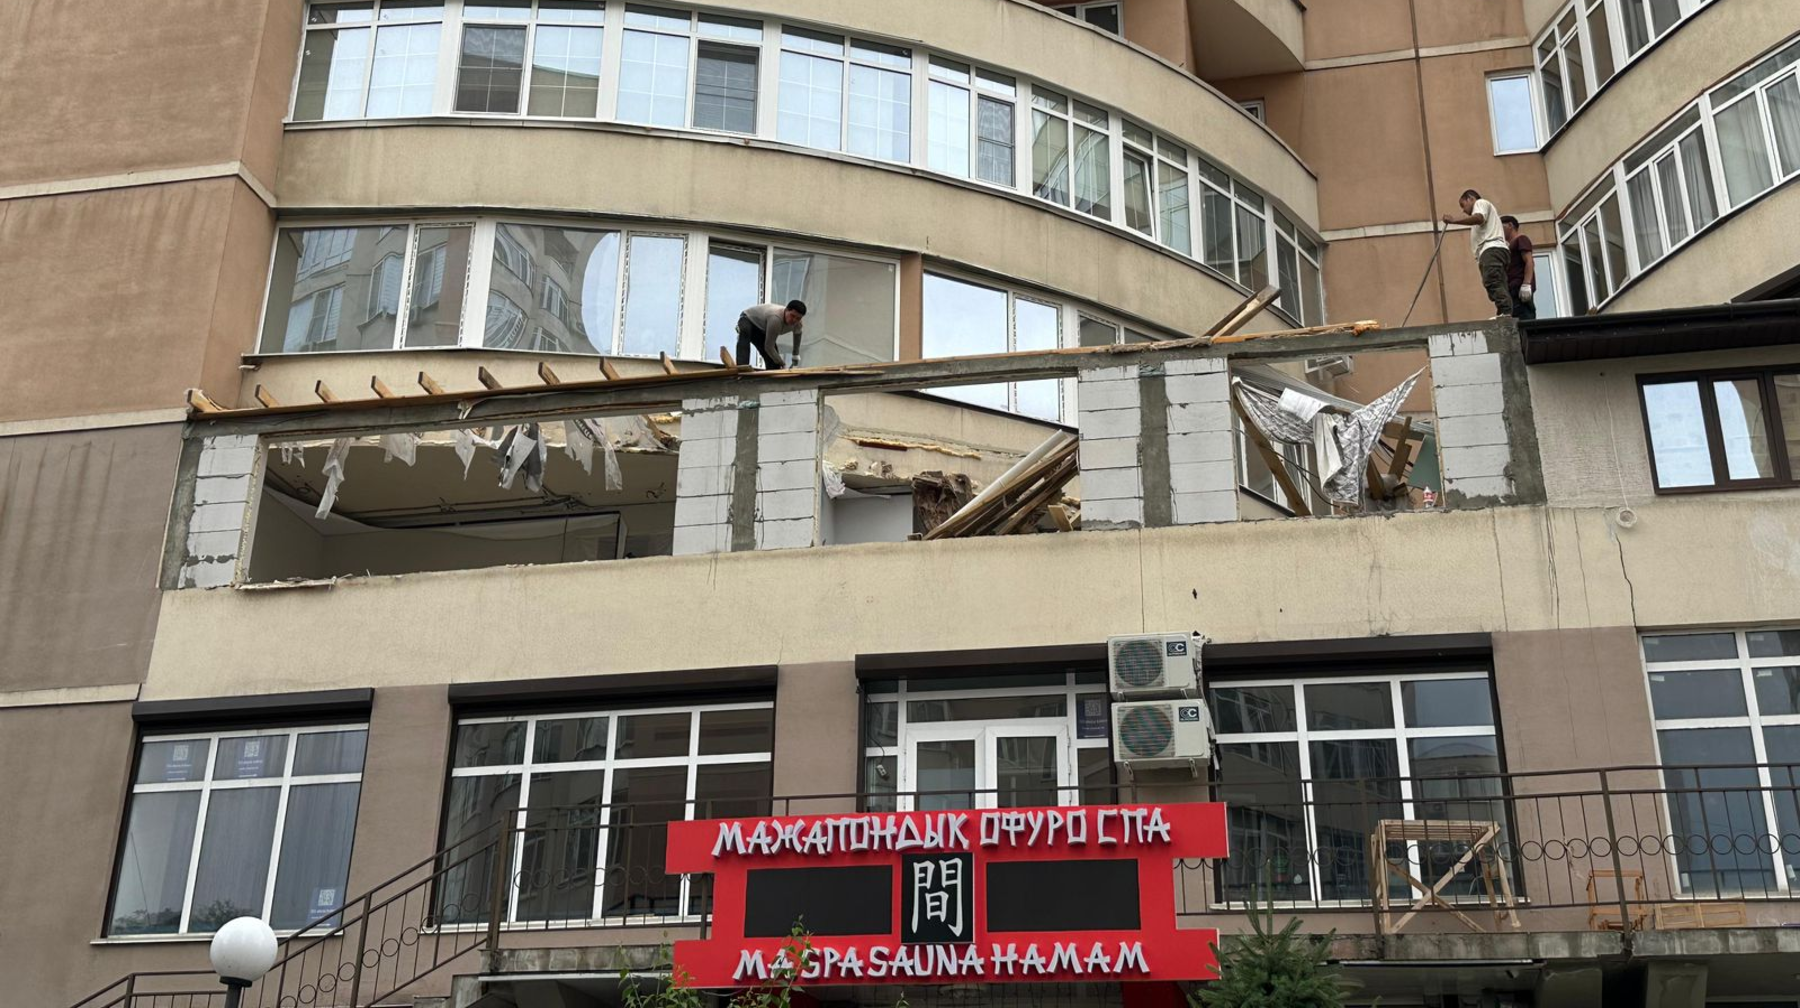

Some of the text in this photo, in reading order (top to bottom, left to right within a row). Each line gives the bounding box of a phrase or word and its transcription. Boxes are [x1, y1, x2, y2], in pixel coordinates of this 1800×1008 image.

[980, 809, 1087, 847] ОФУРО
[1097, 807, 1171, 844] СПА
[911, 857, 963, 937] 間
[867, 944, 985, 978] SAUNA
[990, 942, 1150, 974] HAMAM
